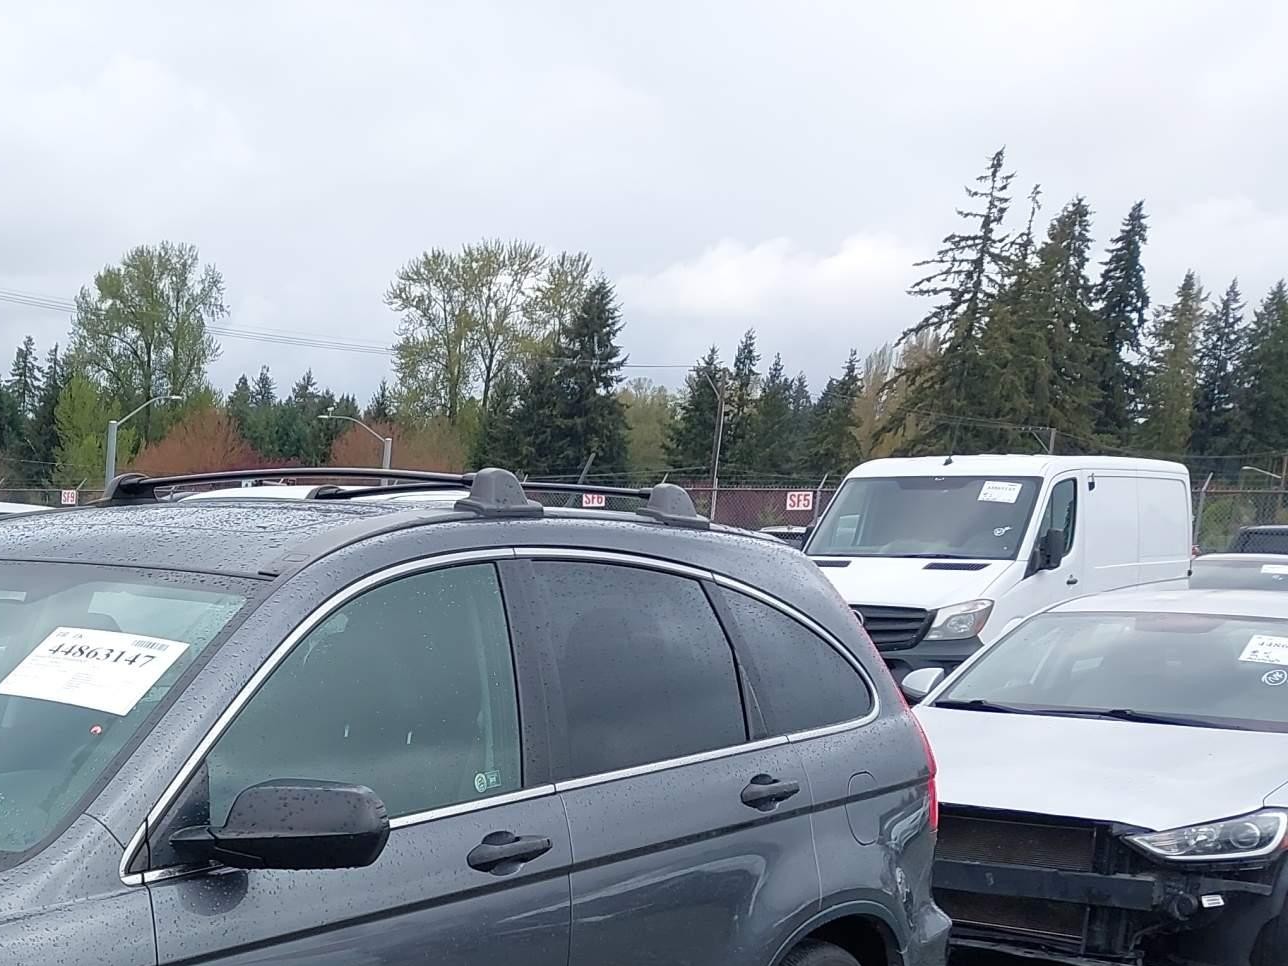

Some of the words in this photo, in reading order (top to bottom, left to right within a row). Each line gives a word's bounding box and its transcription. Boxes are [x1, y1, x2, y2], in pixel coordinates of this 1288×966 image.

[63, 491, 75, 503] SF9
[789, 494, 811, 508] SF5
[49, 642, 157, 668] 44863147
